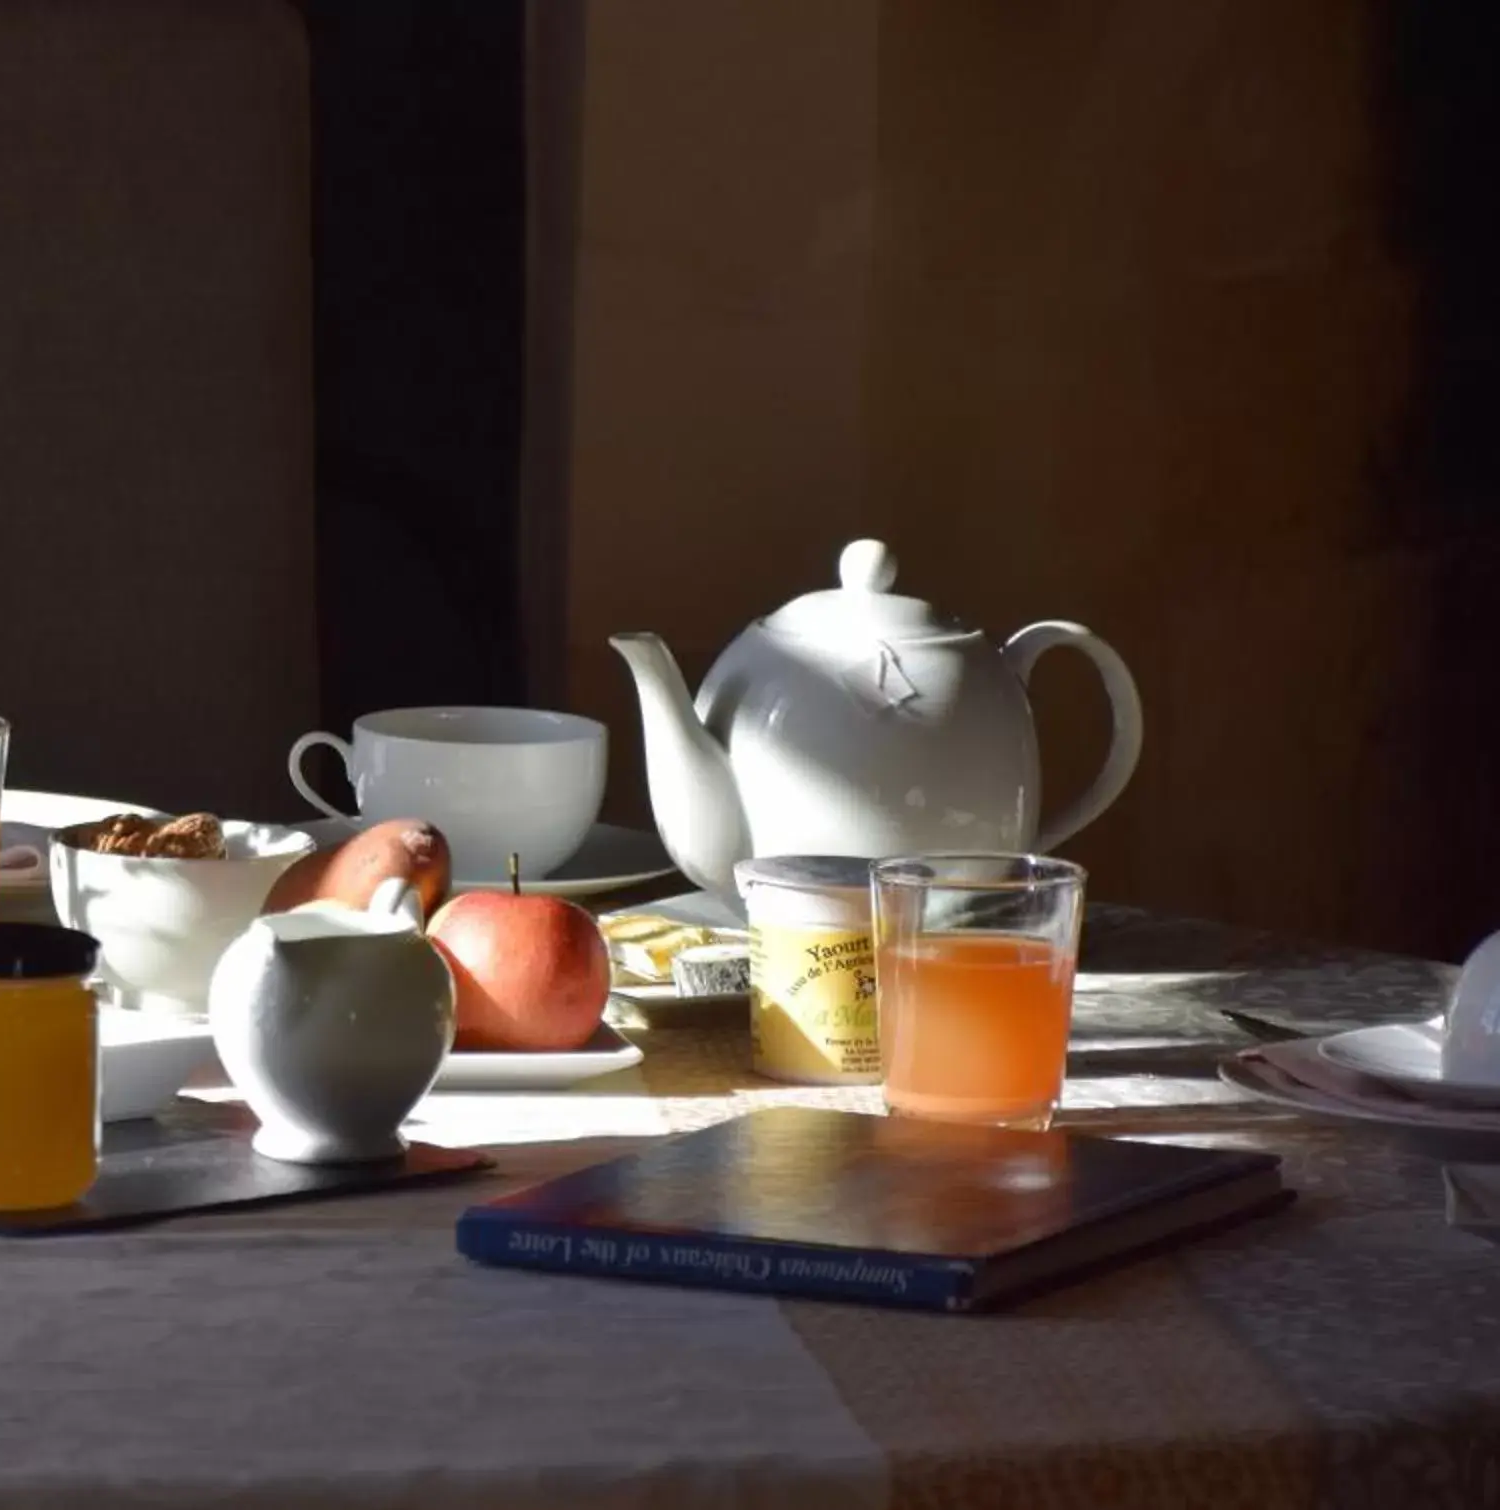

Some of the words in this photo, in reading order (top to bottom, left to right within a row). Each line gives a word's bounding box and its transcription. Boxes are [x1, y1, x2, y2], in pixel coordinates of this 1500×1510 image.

[806, 937, 870, 962] Yaourt
[508, 1230, 571, 1261] Loire
[580, 1238, 617, 1263] the
[624, 1244, 650, 1264] of
[660, 1247, 770, 1281] Châteaux
[778, 1257, 915, 1294] Sumptuous
